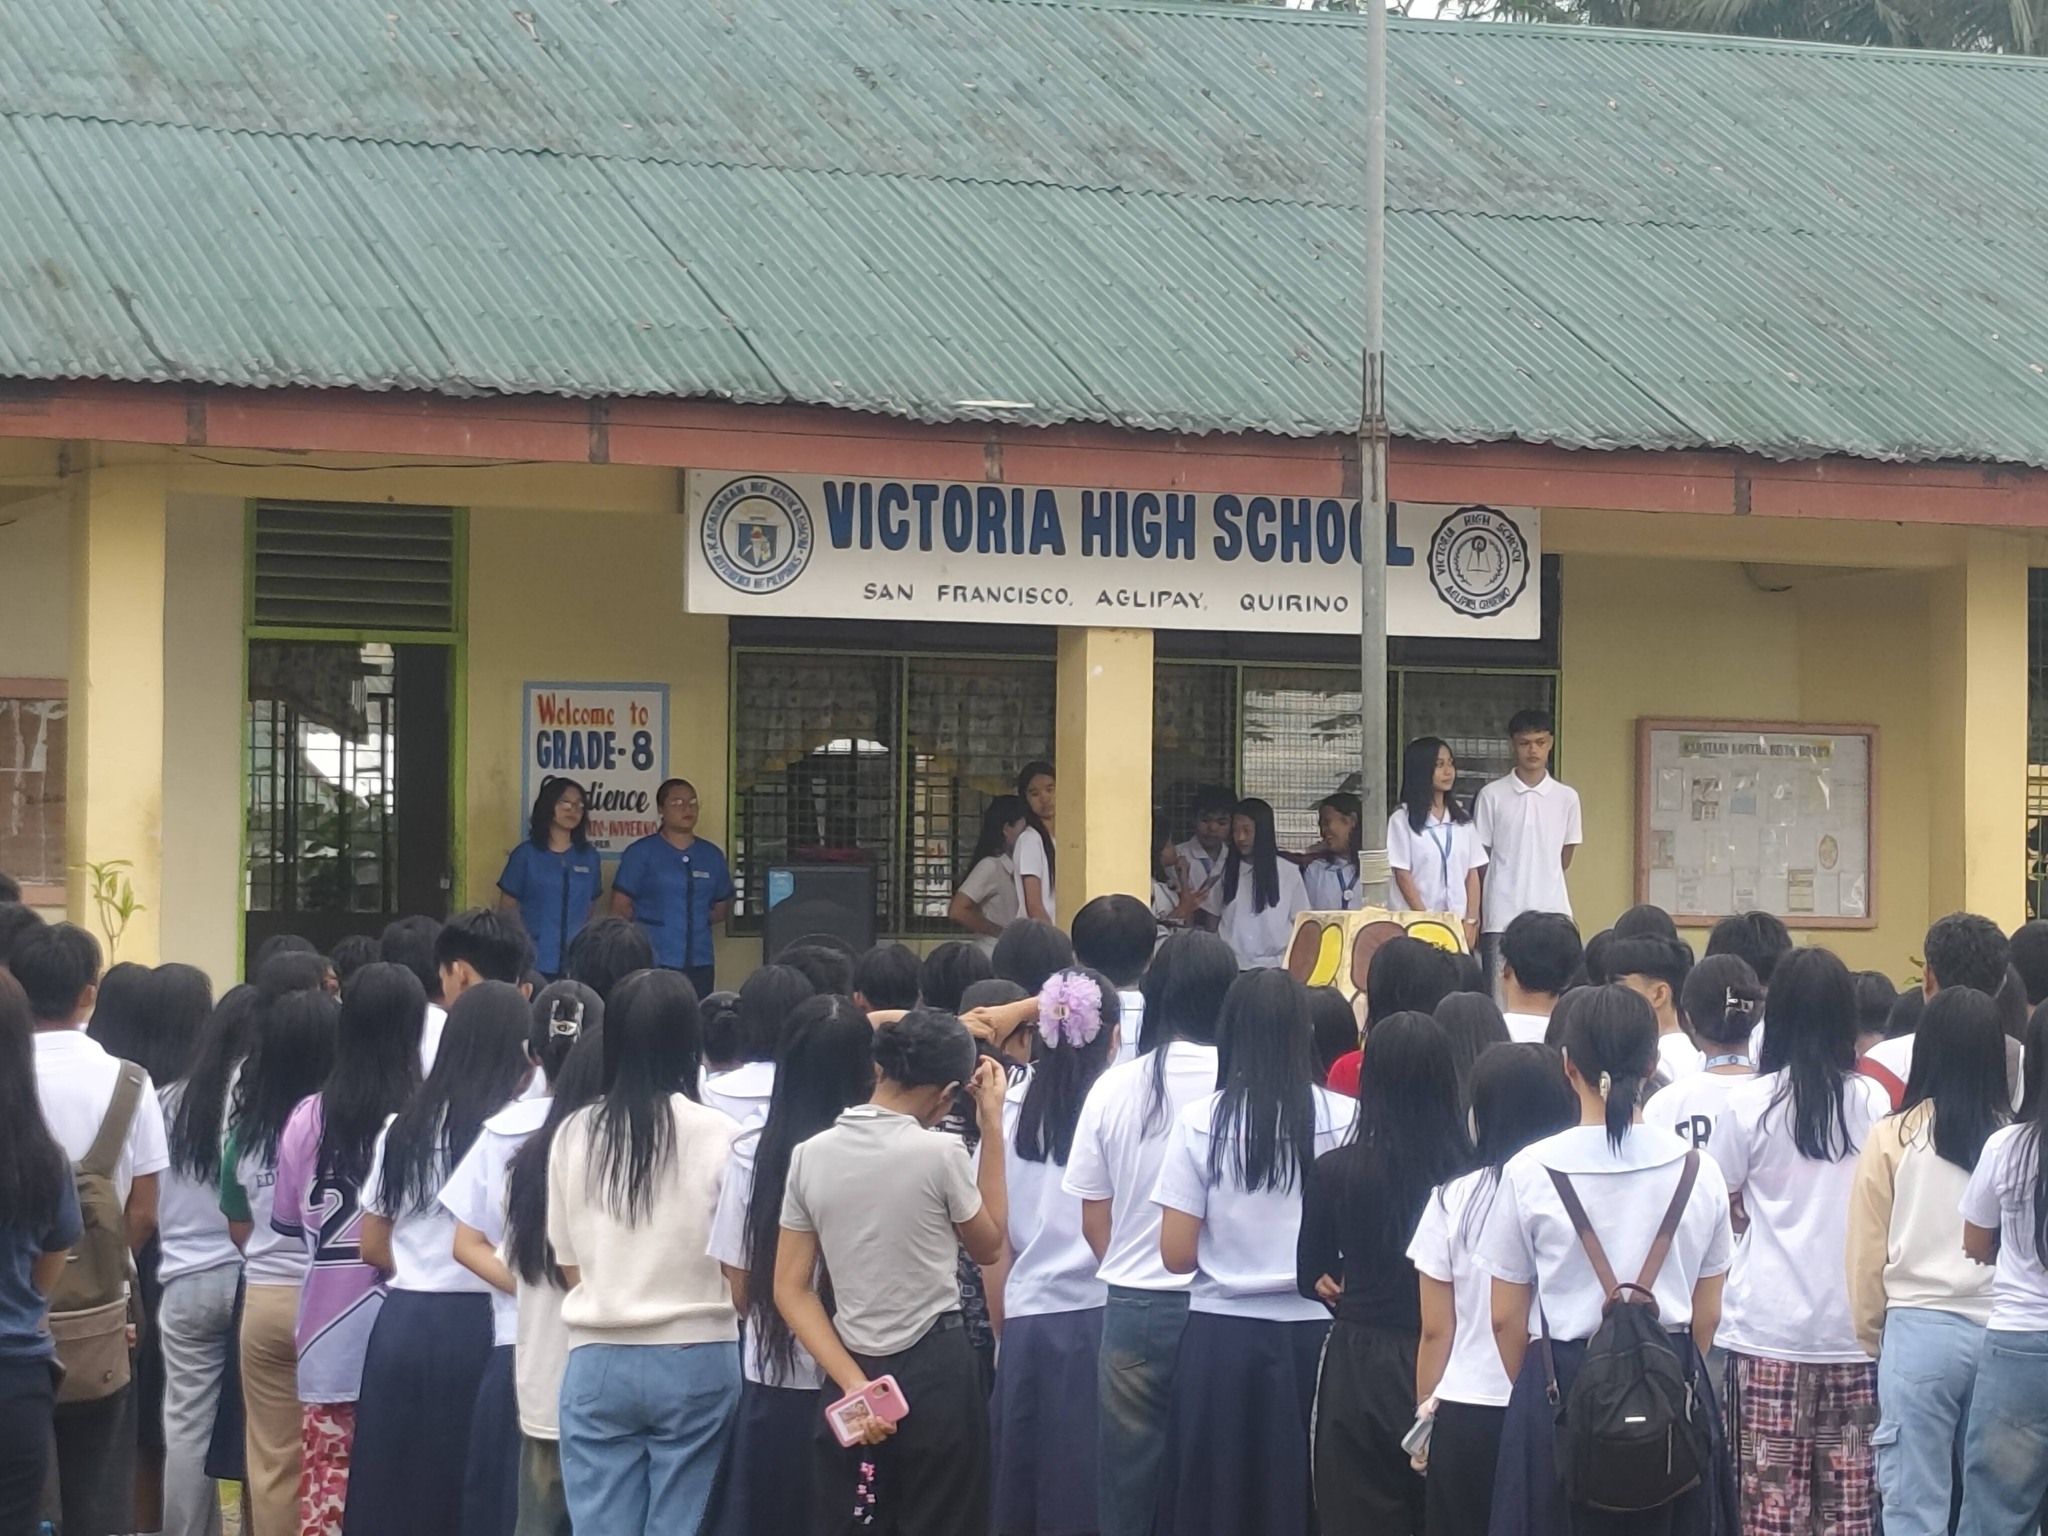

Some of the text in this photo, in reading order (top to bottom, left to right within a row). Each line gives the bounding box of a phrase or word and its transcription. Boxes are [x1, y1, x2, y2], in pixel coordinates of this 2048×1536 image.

[823, 480, 1067, 556] VICTORIA
[1081, 489, 1196, 560] HIGH
[863, 583, 914, 601] SAN
[1240, 593, 1349, 614] QUIRINO
[537, 692, 650, 727] Welcome to
